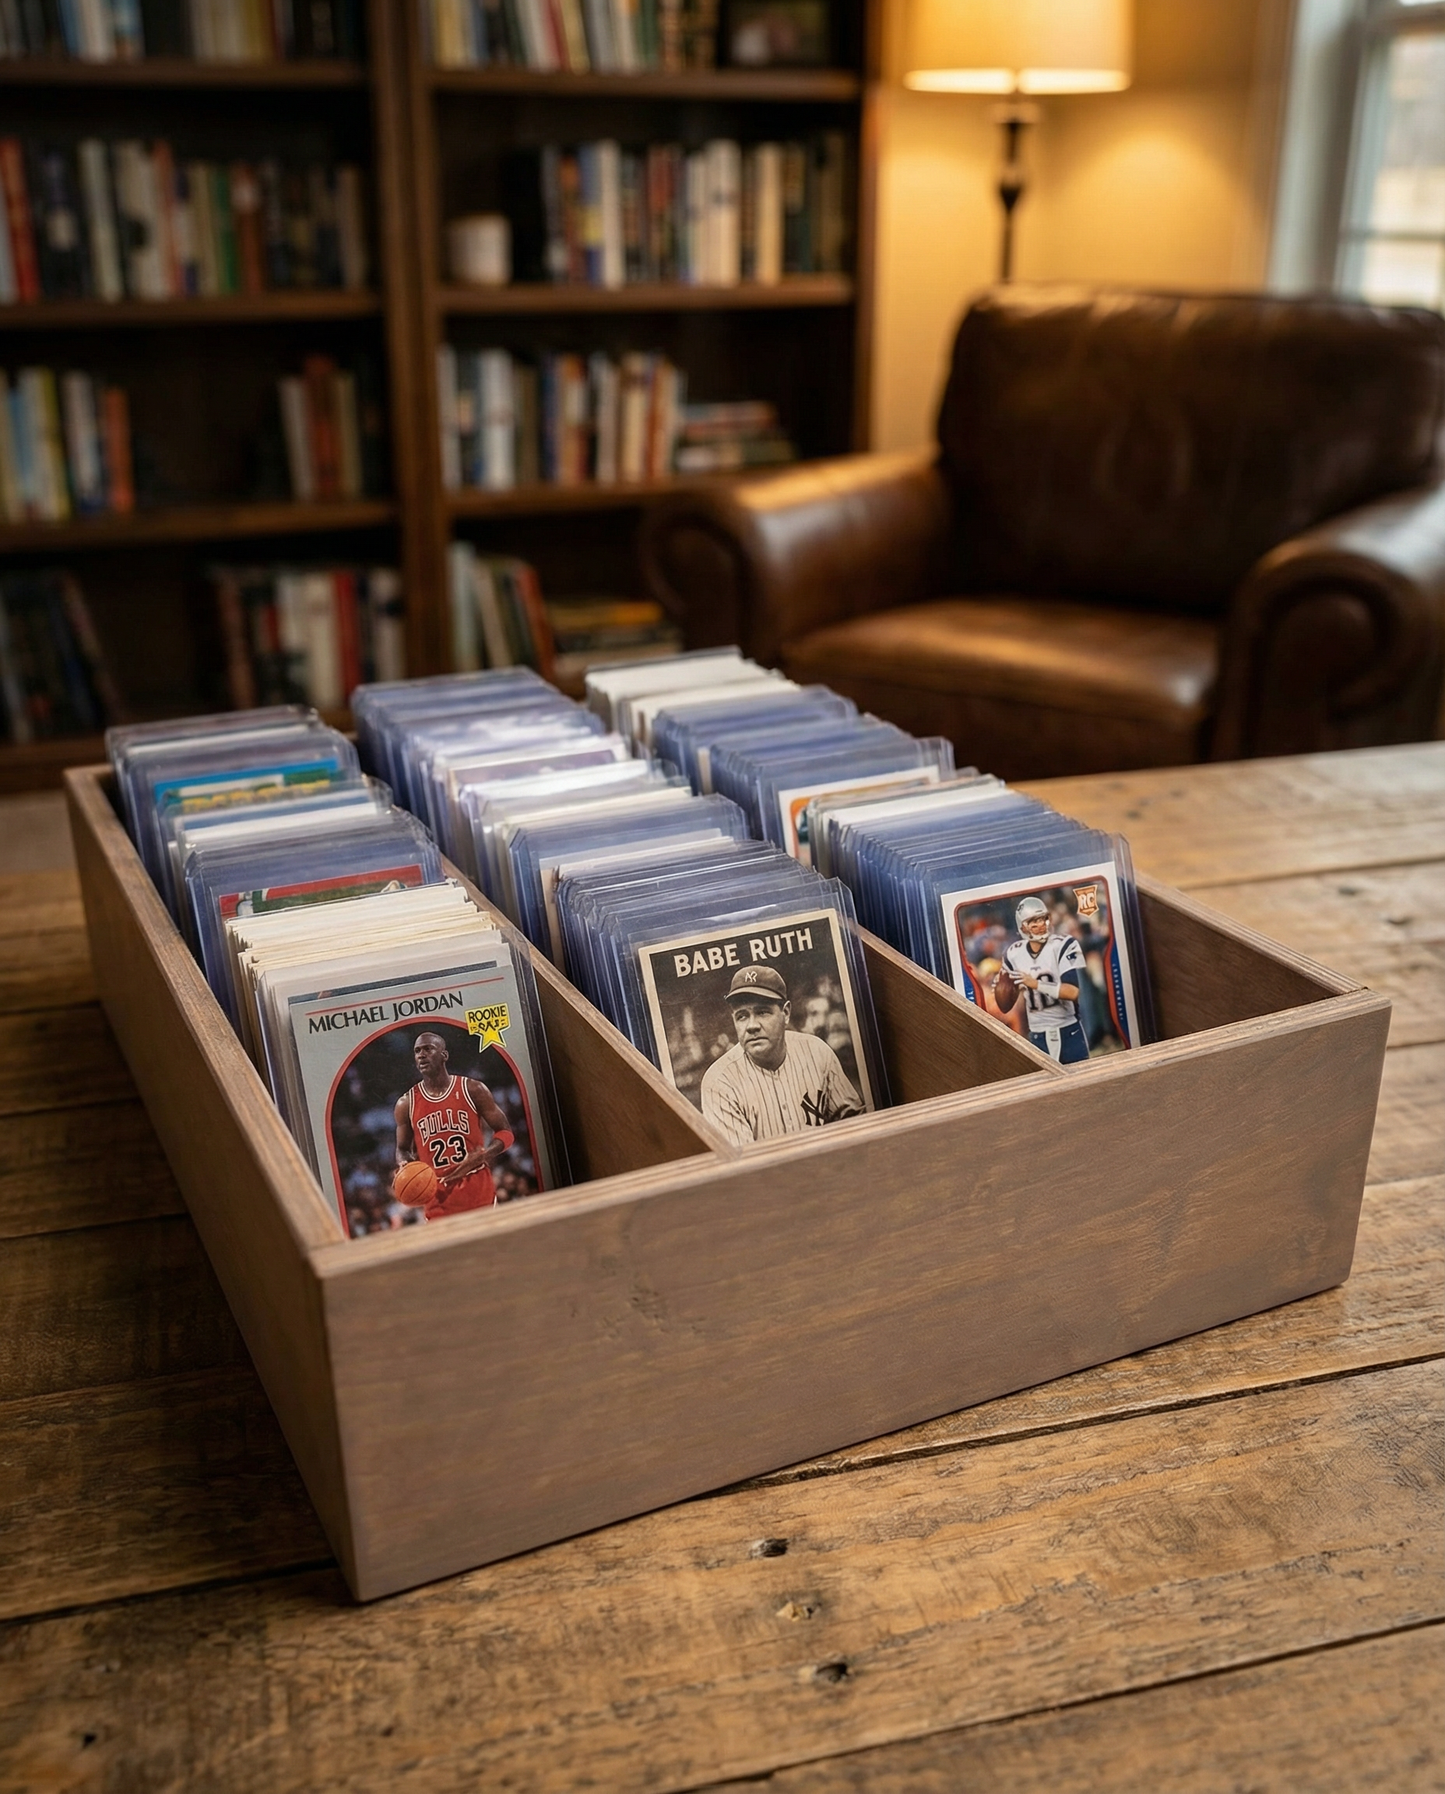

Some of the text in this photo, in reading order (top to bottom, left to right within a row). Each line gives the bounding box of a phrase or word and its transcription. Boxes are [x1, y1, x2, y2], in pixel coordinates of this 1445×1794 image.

[673, 927, 814, 978] BABE RUTH
[308, 991, 464, 1034] MICHAEL JORDAN
[467, 1005, 507, 1023] ROOKIE
[429, 1134, 469, 1169] 23
